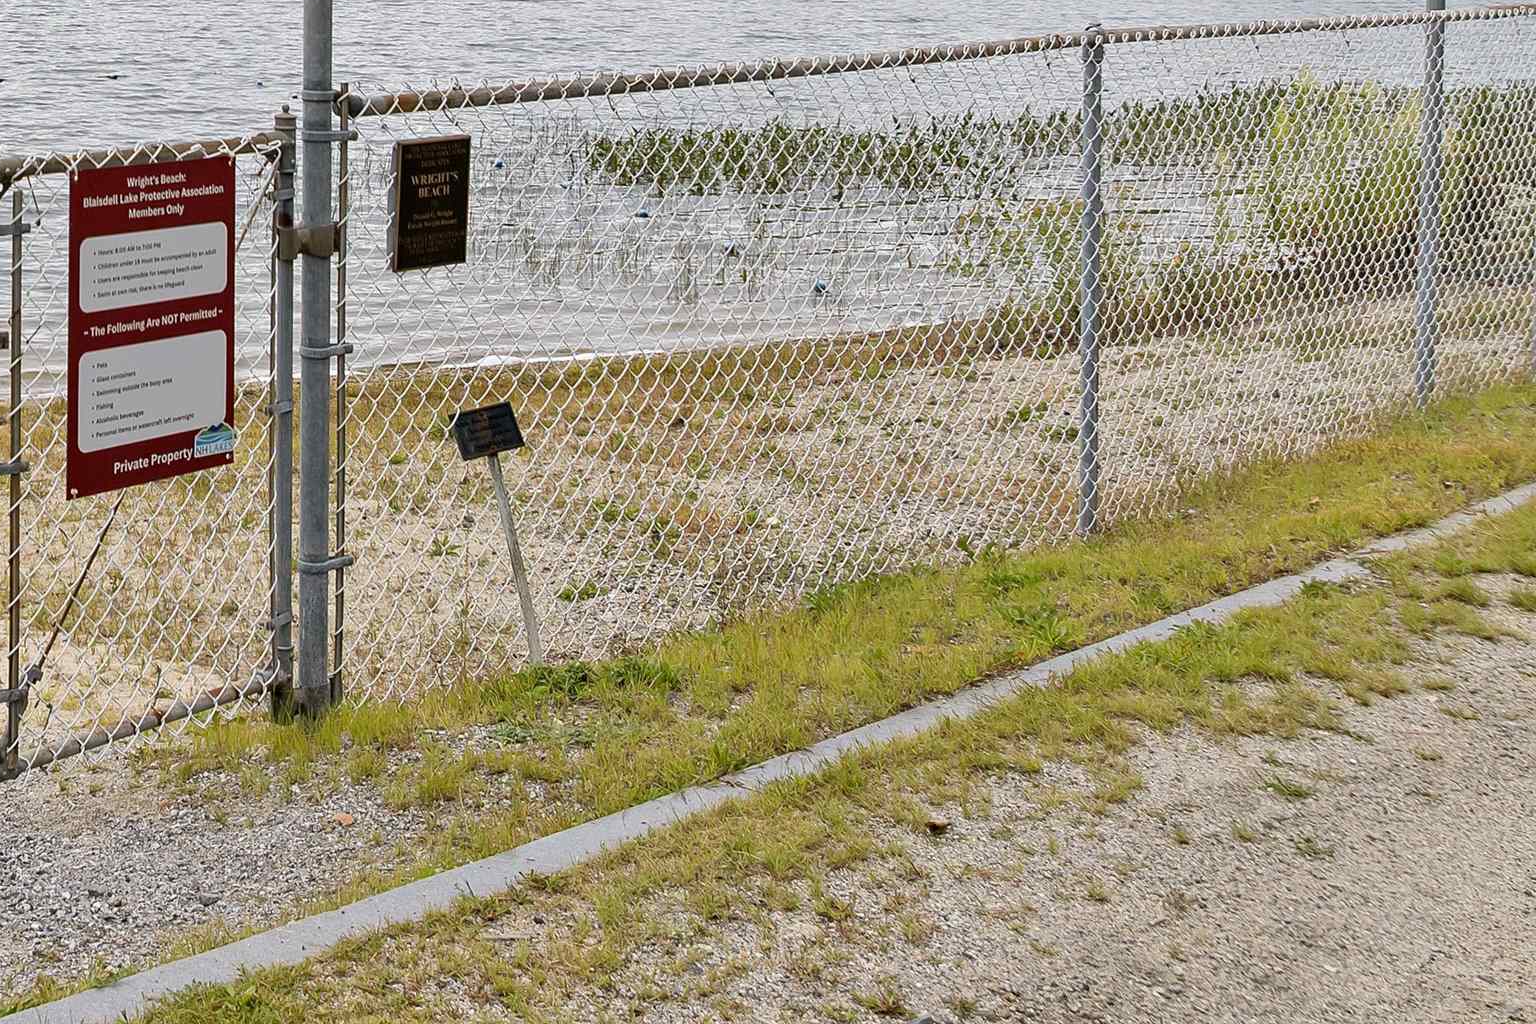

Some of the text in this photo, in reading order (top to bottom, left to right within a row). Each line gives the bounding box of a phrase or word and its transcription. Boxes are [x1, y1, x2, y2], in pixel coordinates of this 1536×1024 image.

[127, 176, 159, 189] Wright's
[83, 184, 224, 208] Blaisdell Lake Protective Association
[128, 203, 185, 219] Members Only
[90, 326, 105, 337] The
[106, 320, 145, 334] Following
[146, 317, 160, 329] Are
[161, 313, 179, 326] NOT
[180, 306, 217, 323] Permitted
[113, 448, 193, 474] Private Property
